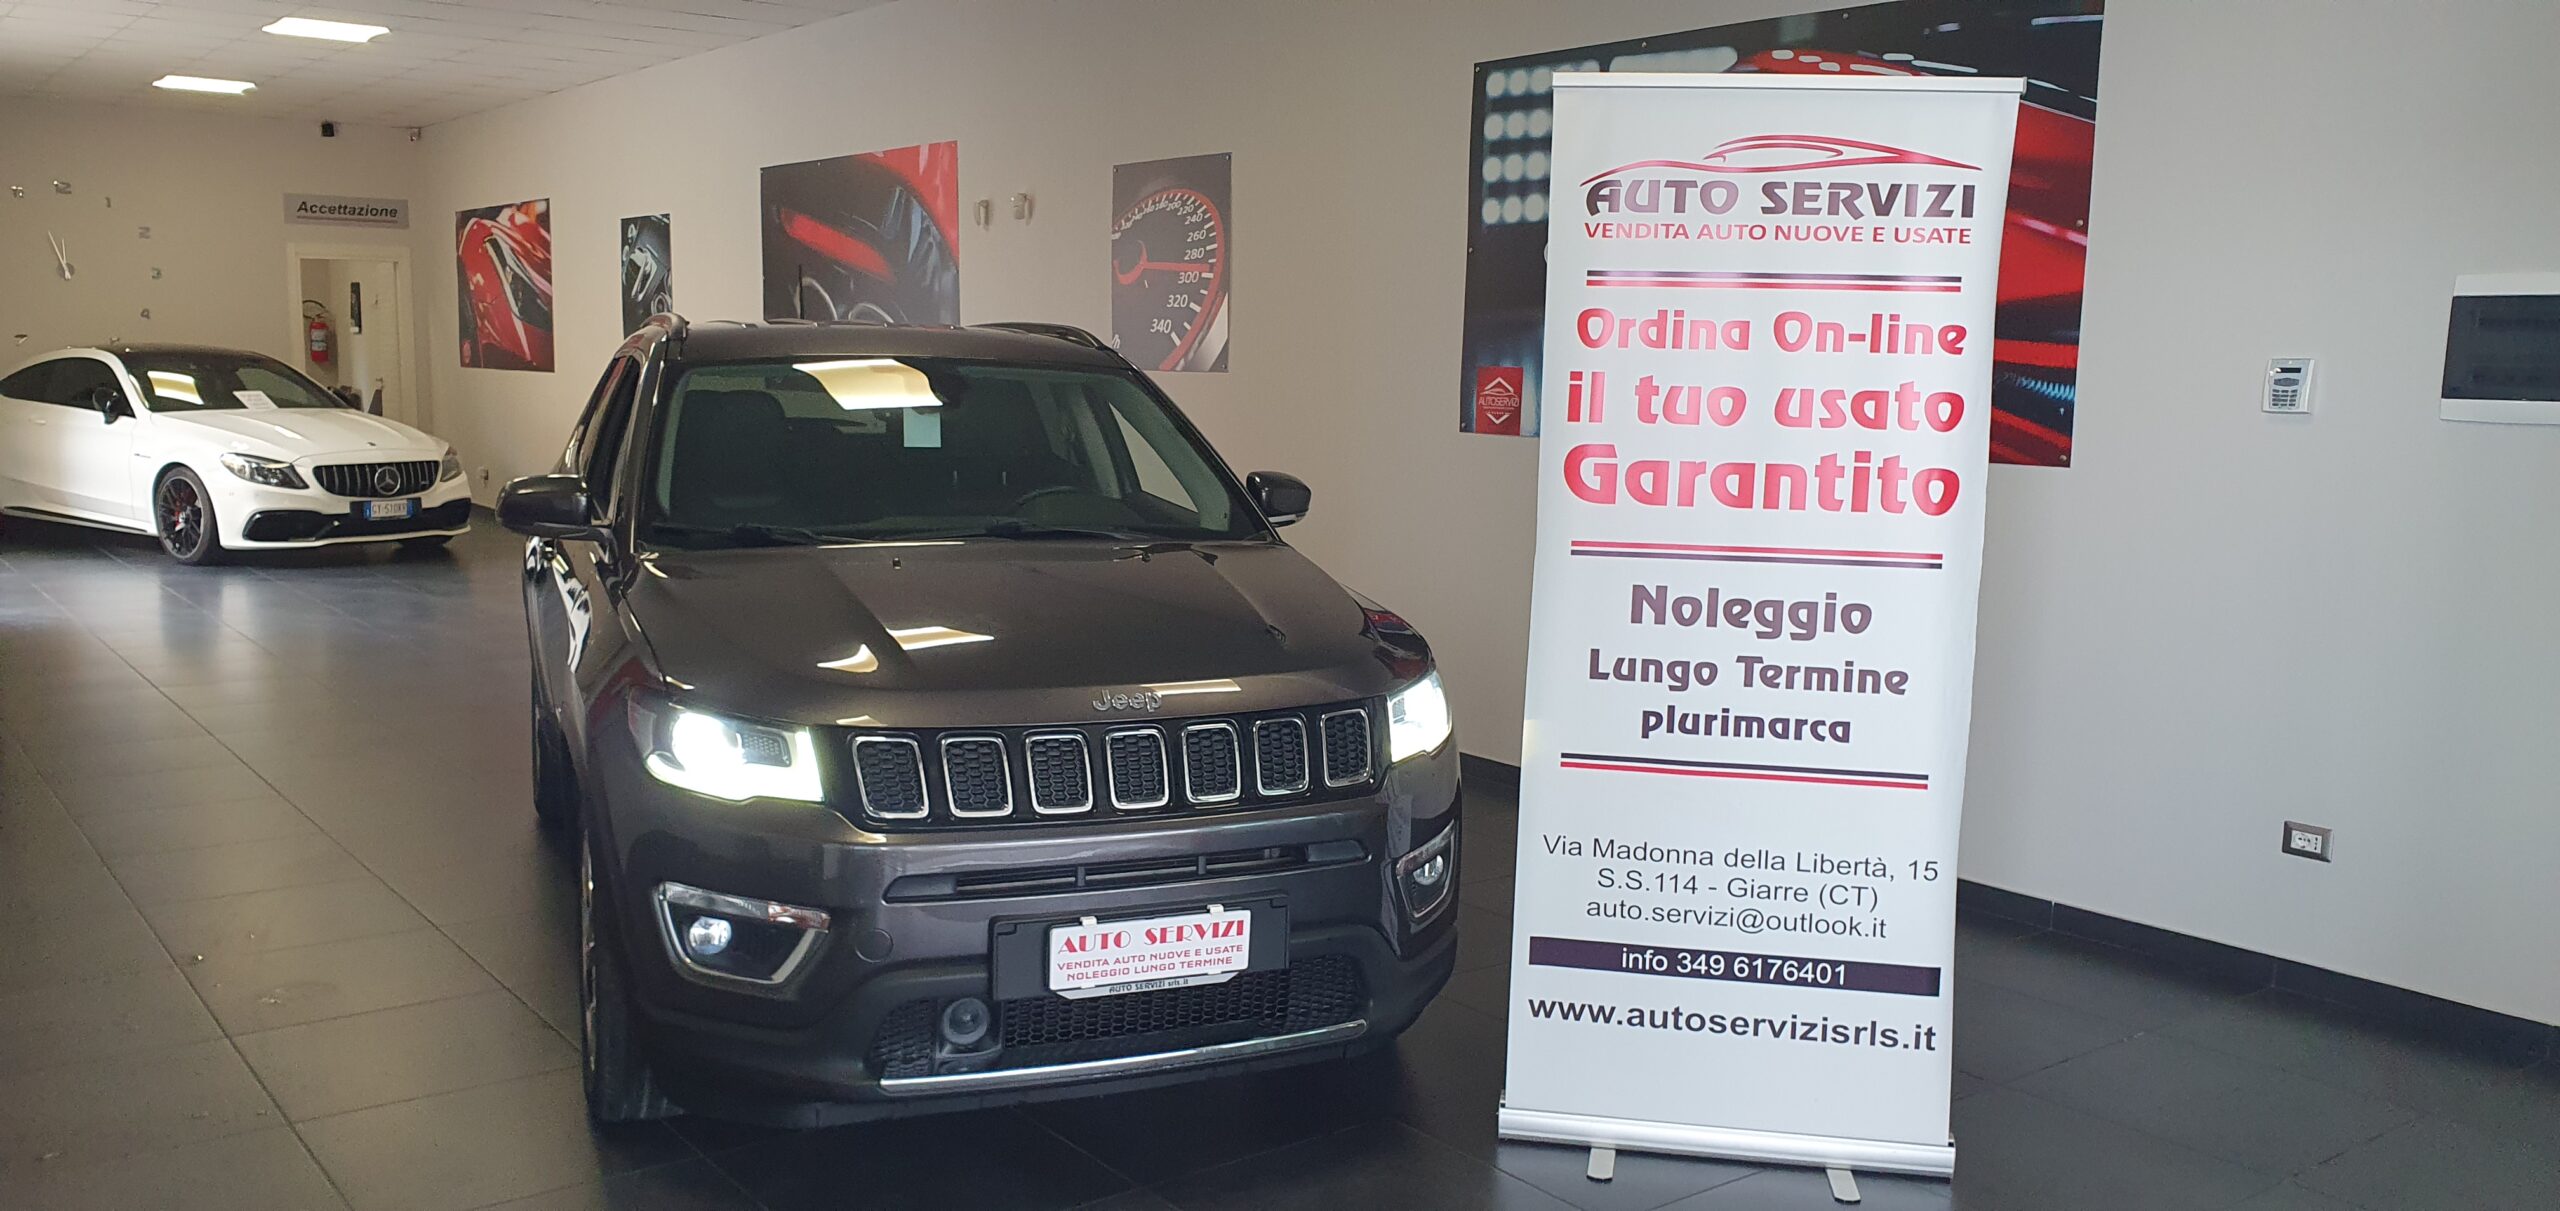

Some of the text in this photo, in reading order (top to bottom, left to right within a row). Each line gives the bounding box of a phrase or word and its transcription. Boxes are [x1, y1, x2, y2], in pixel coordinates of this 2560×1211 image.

[296, 201, 398, 218] Accettazione
[1177, 204, 1194, 216] 220
[1586, 179, 1976, 220] AUTO SERVIZI
[1185, 212, 1203, 225] 240
[1584, 222, 1971, 244] VENDITA AUTO NUOVE E USATE
[1187, 230, 1206, 242] 260
[1184, 248, 1204, 260] 280
[1178, 272, 1199, 284] 300
[1167, 294, 1188, 308] 320
[1150, 318, 1172, 334] 340
[1577, 308, 1967, 355] Ordina On-line
[1567, 370, 1964, 432] il tuo usato
[1563, 443, 1960, 516] Garantito
[1629, 584, 1873, 641] Noleggio
[1589, 648, 1910, 695] Lungo Termine
[1092, 689, 1162, 712] Jeep
[1641, 705, 1851, 744] plurimarca
[1543, 835, 1939, 881] Via Madonna della Libertà, 15
[1597, 869, 1698, 896] S.S.114
[1727, 881, 1809, 903] Giarre
[1819, 884, 1878, 912] (CT)
[1586, 899, 1887, 938] auto.servizi@outlook.it
[1058, 920, 1244, 953] AUTO SERVIZI
[1057, 958, 1109, 971] VENDITA
[1114, 954, 1145, 964] AUTO
[1150, 951, 1190, 961] NUOVE
[1205, 944, 1243, 955] USATE
[1067, 957, 1233, 981] NOLEGGIO LUNGO TERMINE
[1621, 948, 1846, 985] info 349 6176401
[1109, 984, 1132, 994] AUTO
[1135, 981, 1166, 991] SERVIZI
[1528, 999, 1936, 1051] www.autoservizisrls.it
